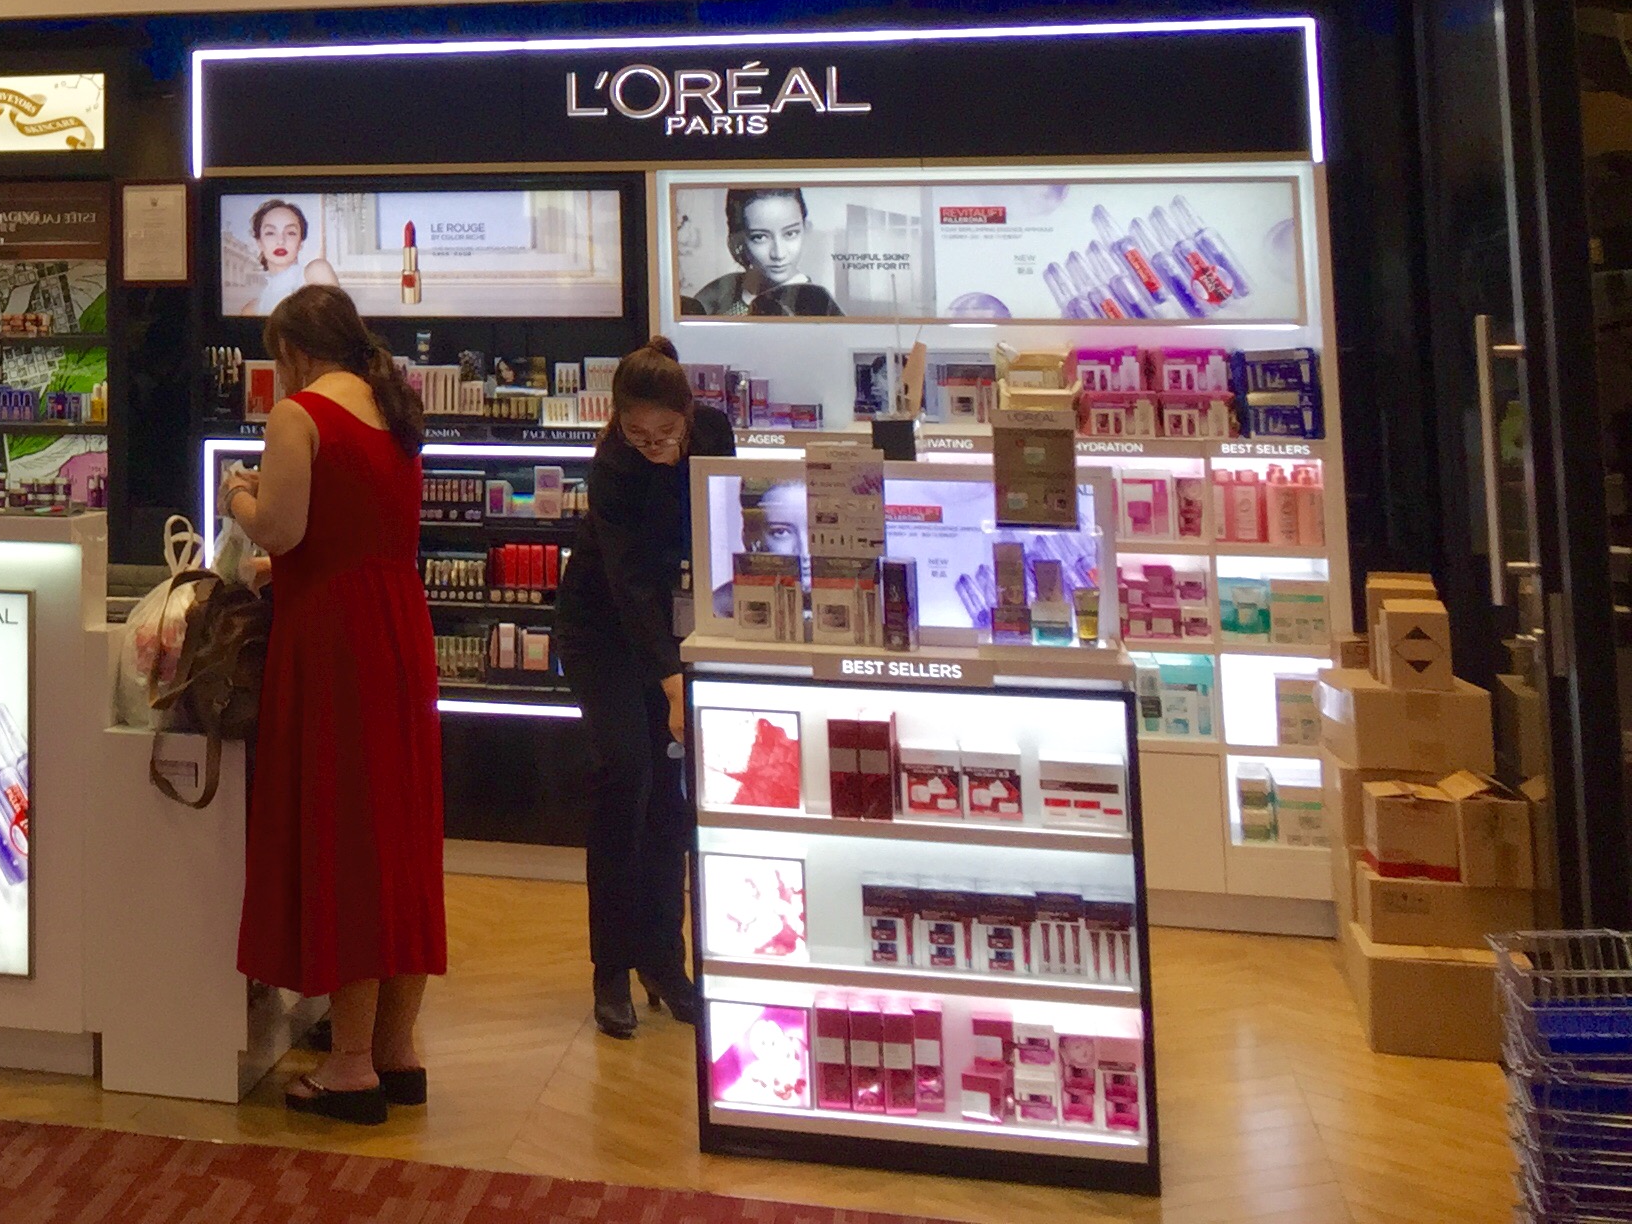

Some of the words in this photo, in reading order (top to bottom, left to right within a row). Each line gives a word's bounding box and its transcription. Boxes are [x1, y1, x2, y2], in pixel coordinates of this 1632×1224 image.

[565, 60, 872, 119] L'ORÉAL
[24, 117, 77, 135] SKINCARE
[664, 114, 769, 136] PARIS
[430, 222, 444, 233] LE
[446, 222, 485, 233] ROUGE
[831, 253, 881, 262] YOUTHFUL
[882, 253, 910, 262] SKIN?
[847, 262, 875, 270] FIGHT
[876, 262, 897, 270] FOR
[747, 434, 786, 446] AGERS
[1221, 443, 1253, 455] BEST
[1255, 443, 1311, 456] SELLERS
[841, 658, 885, 676] BEST
[887, 660, 963, 680] SELLERS
